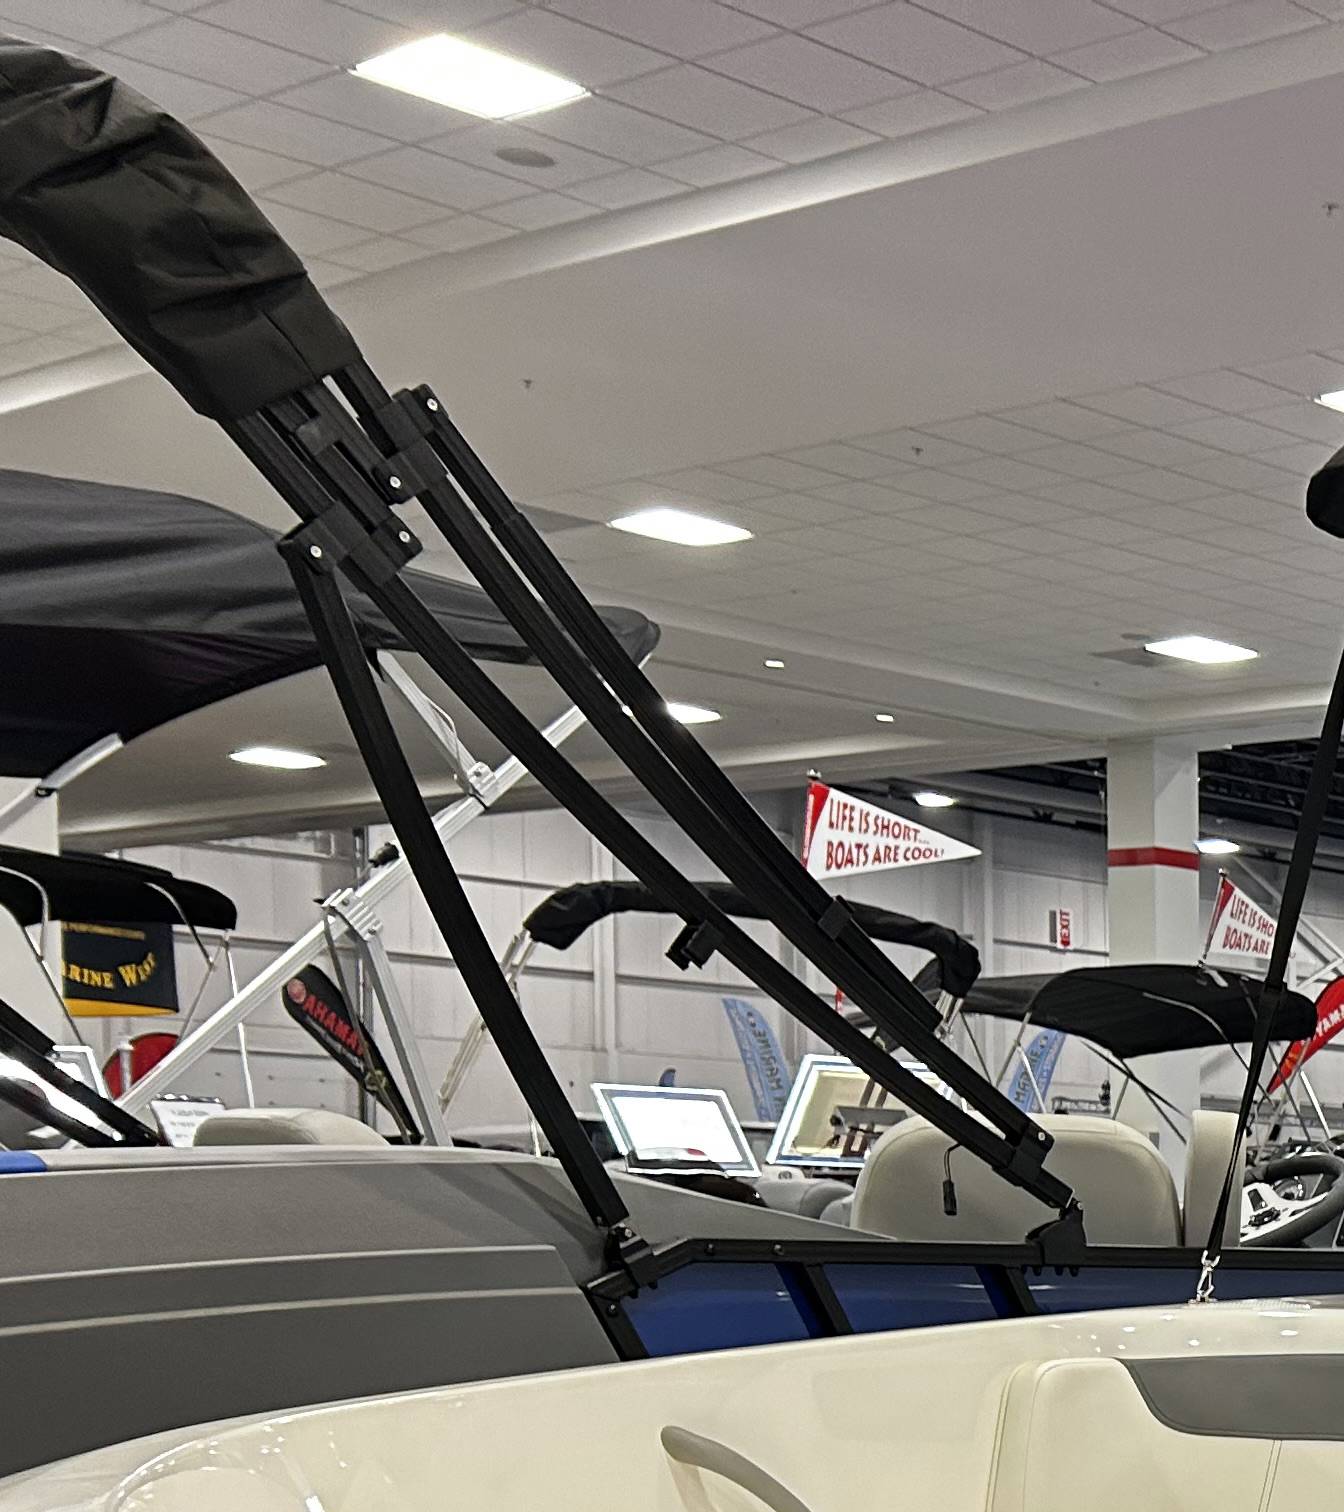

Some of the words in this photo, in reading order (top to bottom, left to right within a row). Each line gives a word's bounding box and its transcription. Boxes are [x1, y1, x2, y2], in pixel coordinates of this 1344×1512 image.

[828, 799, 855, 833] LIFE
[858, 808, 870, 833] IS
[825, 841, 870, 871] BOATS
[871, 843, 900, 863] ARE
[903, 846, 945, 861] COOL!
[1060, 908, 1070, 938] EXIT
[1230, 892, 1248, 925] LIFE
[1248, 906, 1257, 927] IS
[1256, 914, 1275, 937] SHO
[1222, 925, 1253, 950] BOATS
[1252, 934, 1271, 955] ARE
